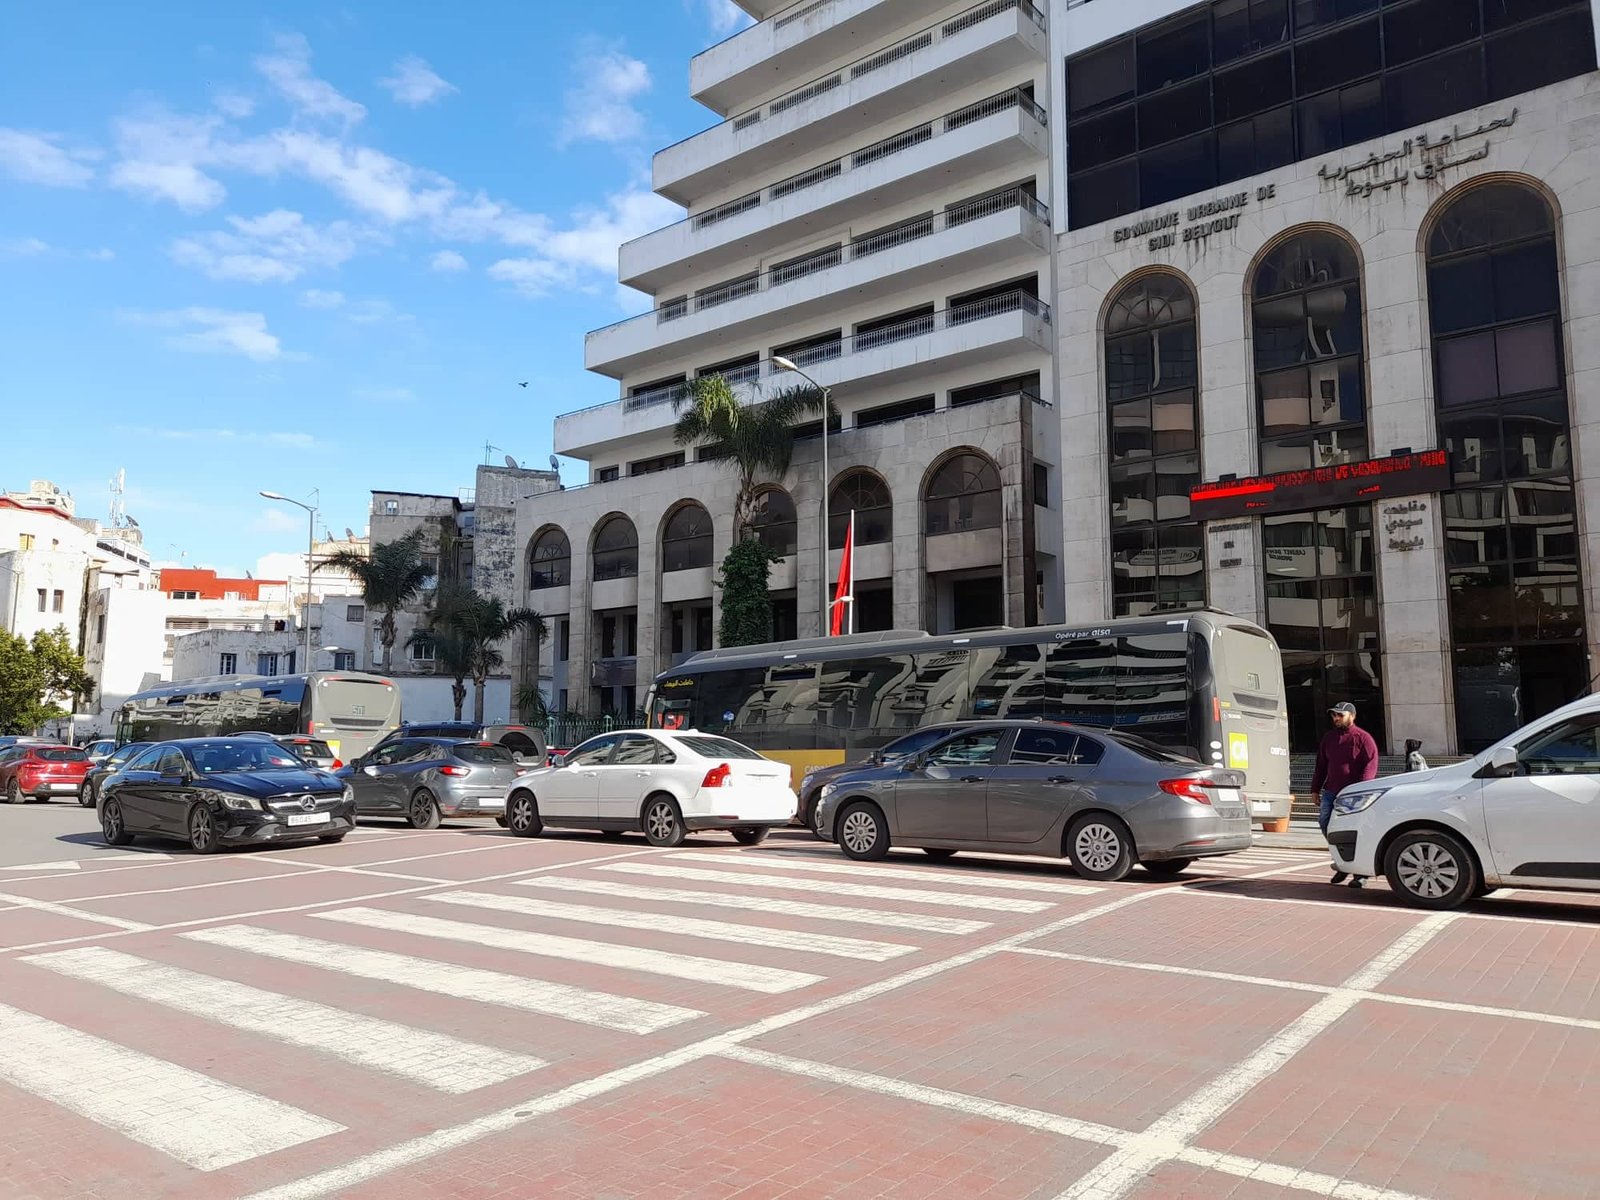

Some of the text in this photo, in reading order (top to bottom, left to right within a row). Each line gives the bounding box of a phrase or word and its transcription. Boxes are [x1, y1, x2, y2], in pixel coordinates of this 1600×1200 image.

[1113, 184, 1276, 243] COMMUNE URBAINE DE
[1148, 213, 1242, 251] SIDI BELYOUT
[1055, 631, 1077, 640] Opéré
[1091, 628, 1111, 637] alsa
